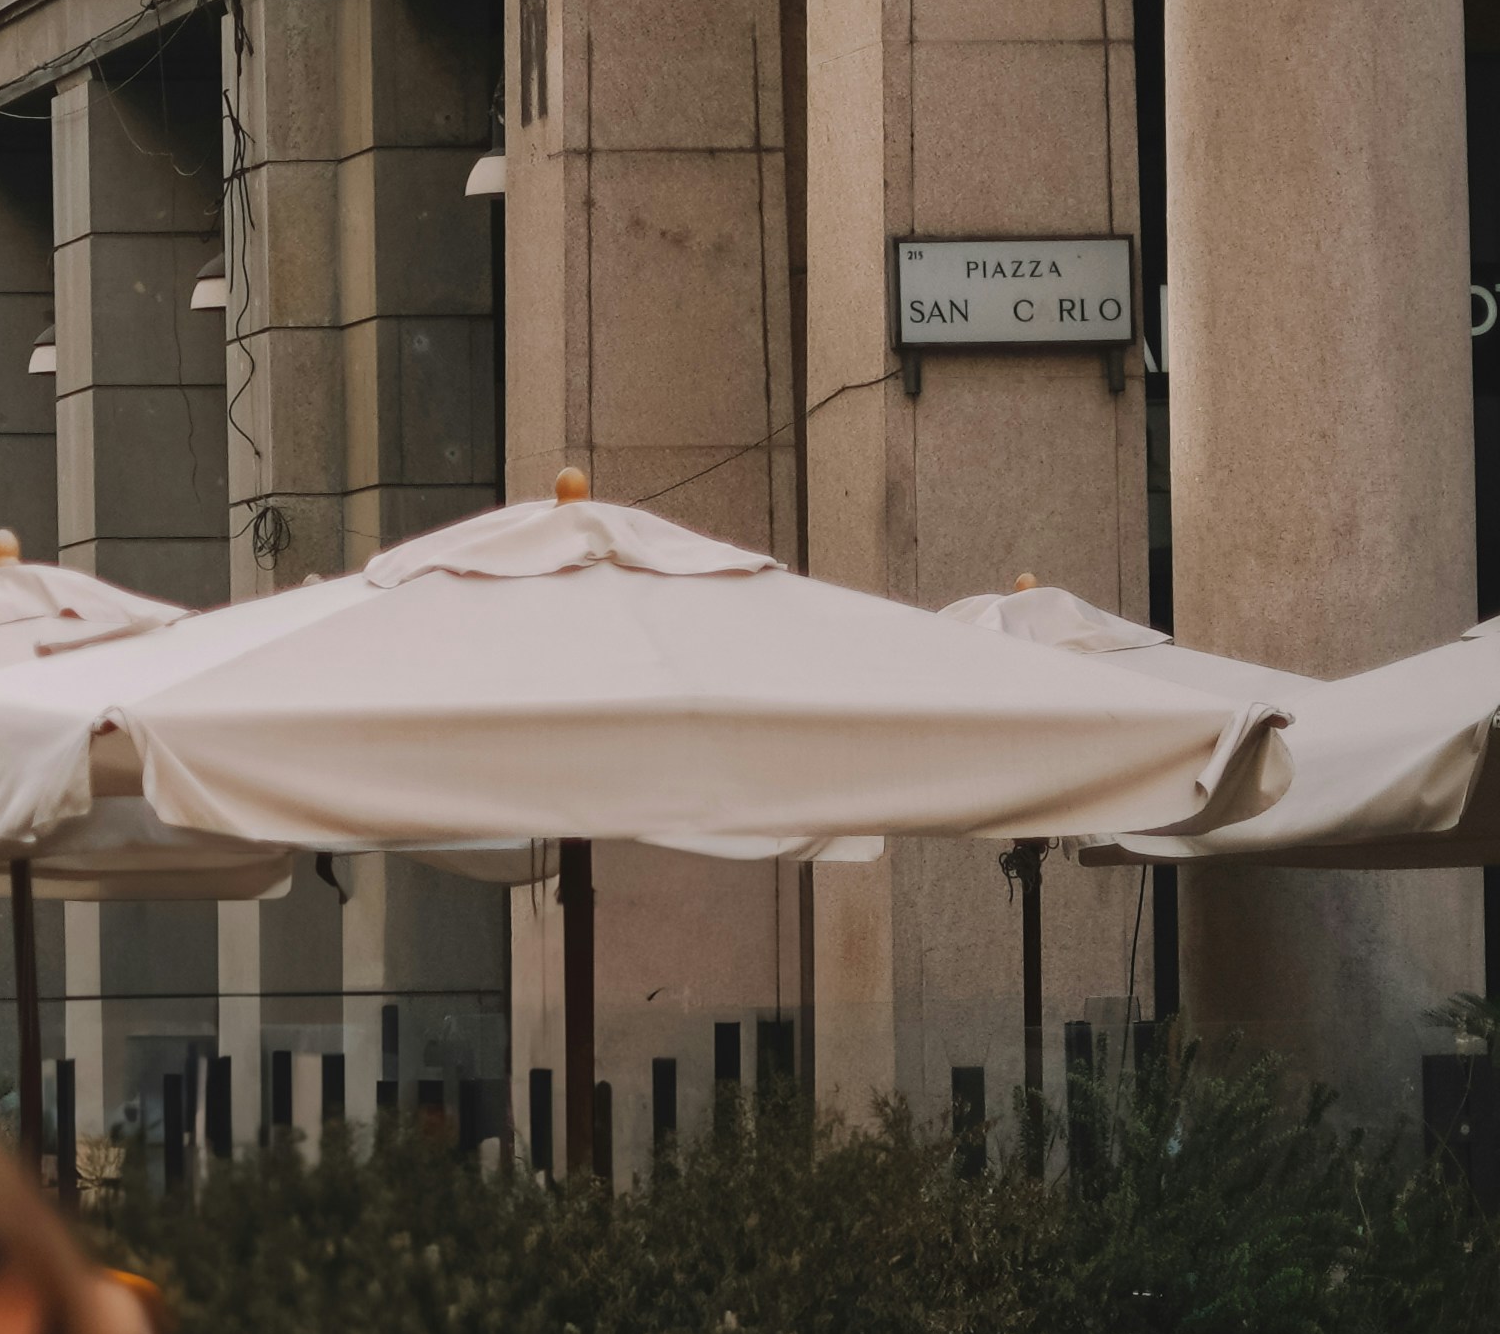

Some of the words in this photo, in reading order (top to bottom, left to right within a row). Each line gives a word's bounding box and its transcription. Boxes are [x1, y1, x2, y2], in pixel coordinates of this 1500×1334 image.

[907, 250, 924, 260] 215
[966, 260, 1062, 279] PIAZZA
[909, 299, 970, 324] SAN
